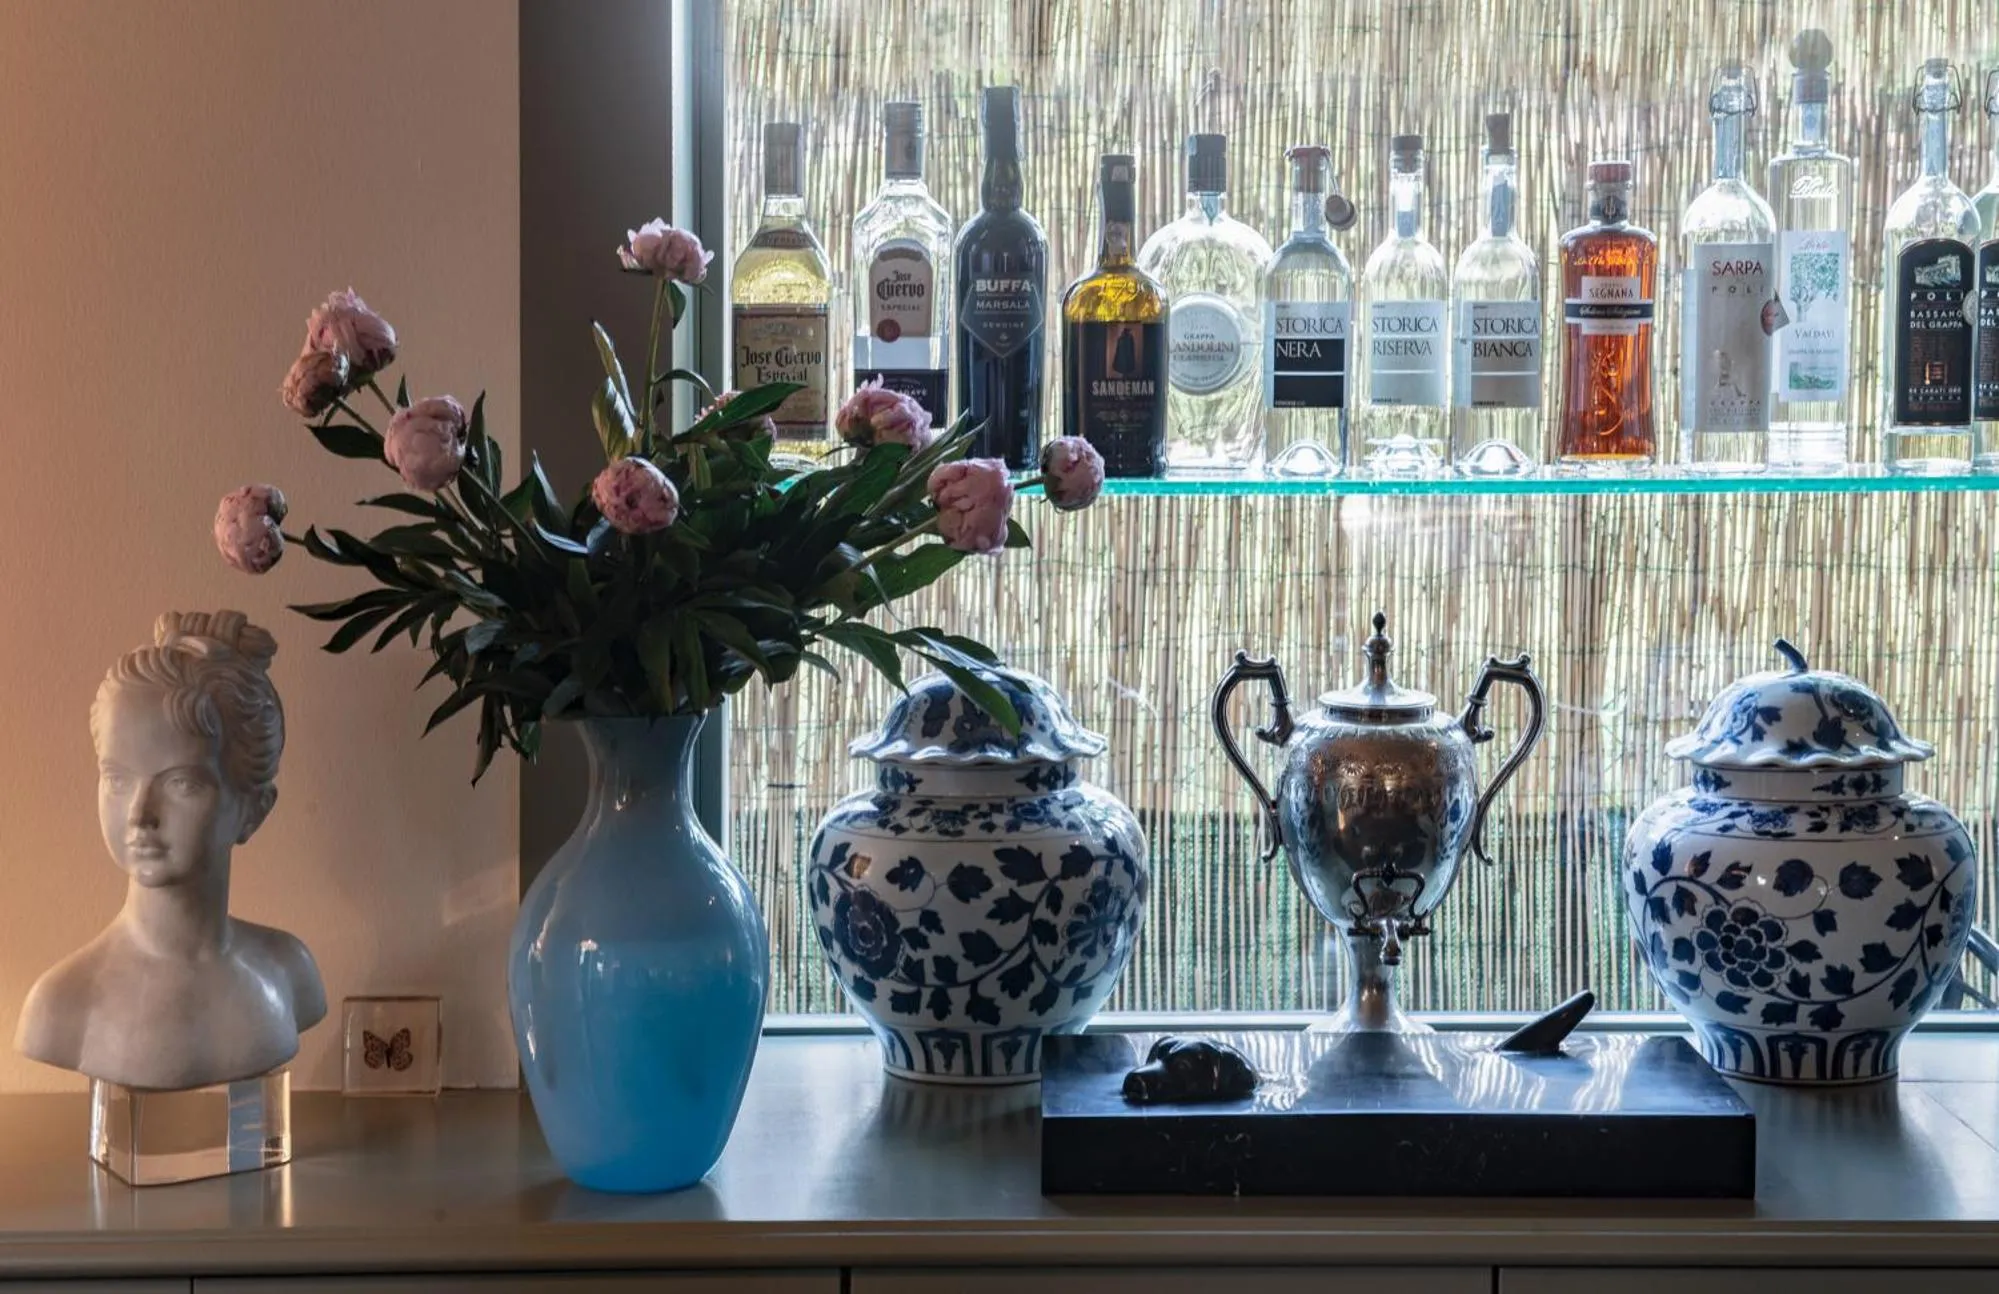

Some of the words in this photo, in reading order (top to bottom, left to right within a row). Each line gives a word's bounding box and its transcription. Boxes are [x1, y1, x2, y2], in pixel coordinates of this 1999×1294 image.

[892, 270, 912, 282] Jose
[1712, 260, 1764, 276] SARPA
[876, 277, 925, 300] Cuervo
[976, 279, 1031, 292] BUFFA
[1589, 287, 1634, 298] SEGNANA
[1712, 285, 1764, 294] POLI
[1910, 291, 1964, 301] POLI
[976, 300, 1030, 310] MARSALA
[1910, 309, 1963, 319] BASSANO
[1276, 317, 1344, 334] STORICA
[1372, 316, 1439, 332] STORICA
[1473, 318, 1539, 334] STORICA
[1910, 320, 1927, 329] DEL
[1929, 320, 1963, 329] GRAPPA
[1276, 341, 1322, 358] NERA
[1373, 340, 1433, 356] RISERVA
[1473, 341, 1533, 357] BIANCA
[741, 346, 772, 367] Jose
[775, 346, 822, 368] Cuervo
[757, 366, 807, 384] Especial
[1092, 380, 1155, 396] SANDEMAN
